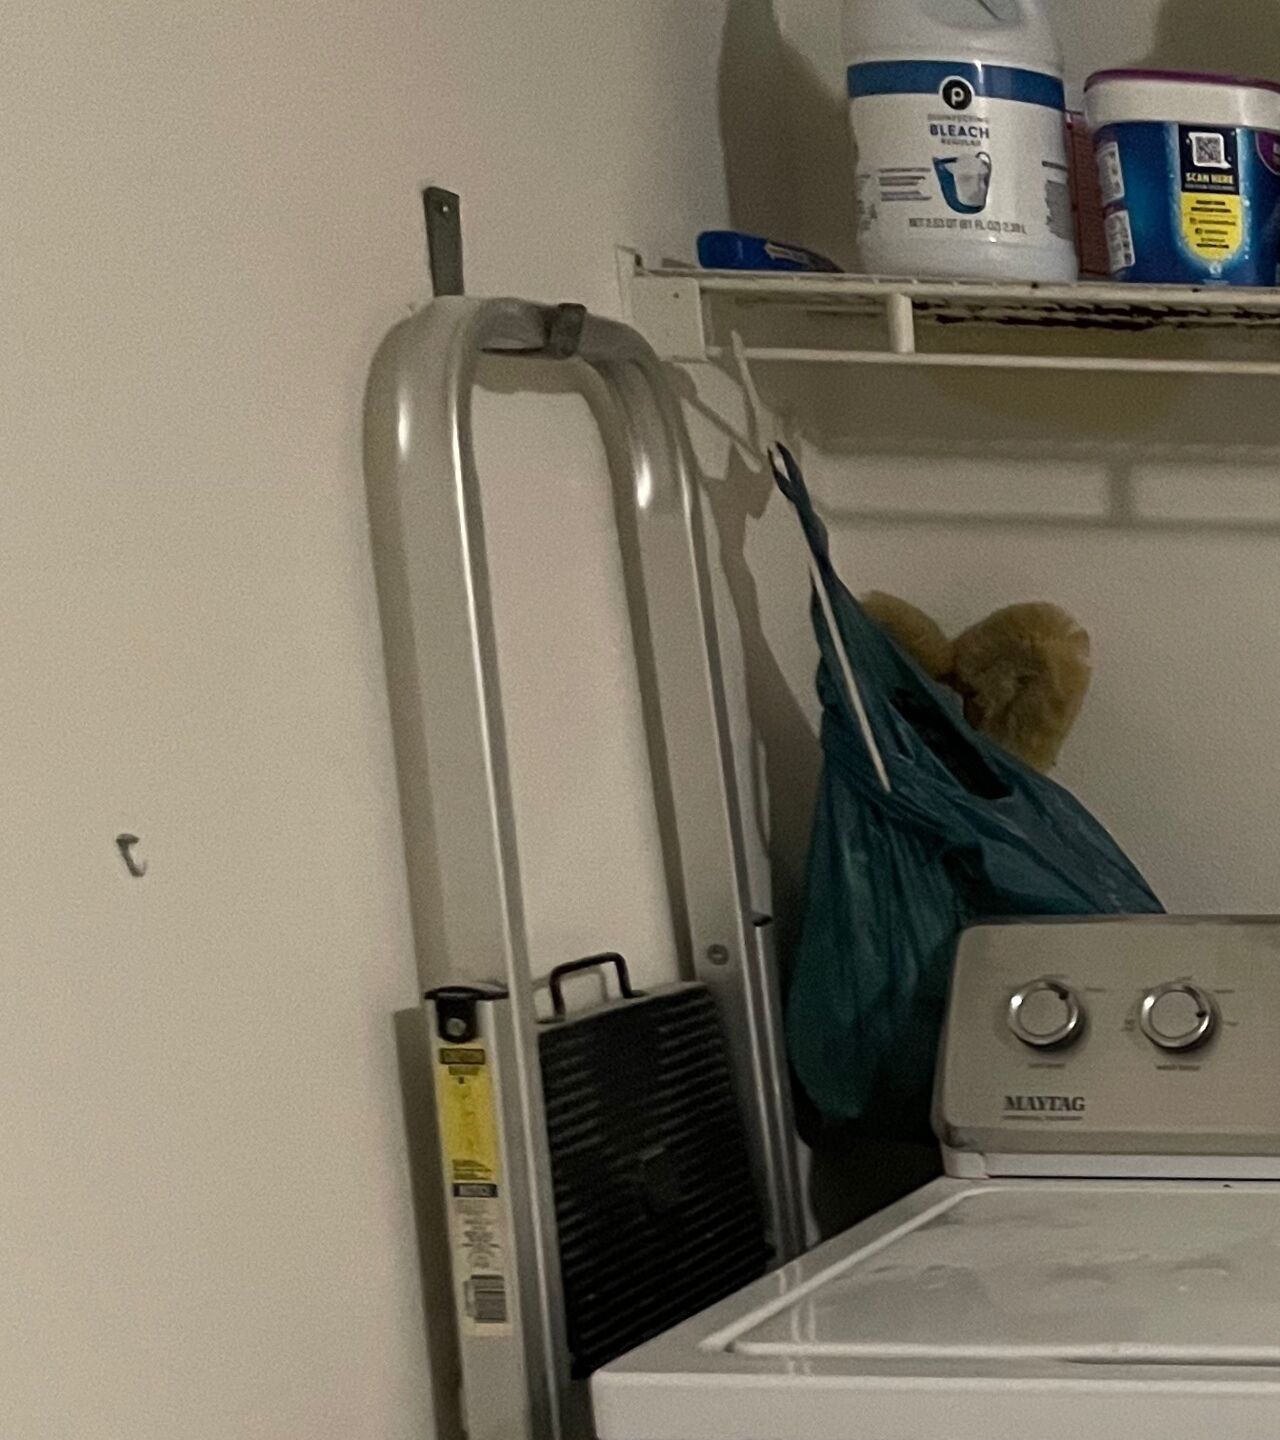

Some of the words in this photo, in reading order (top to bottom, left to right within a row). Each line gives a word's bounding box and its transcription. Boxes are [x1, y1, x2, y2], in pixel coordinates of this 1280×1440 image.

[929, 124, 990, 139] BLEACH
[1185, 172, 1209, 184] SCAN
[1211, 173, 1234, 185] HERE
[1003, 1095, 1086, 1111] MAYTAG
